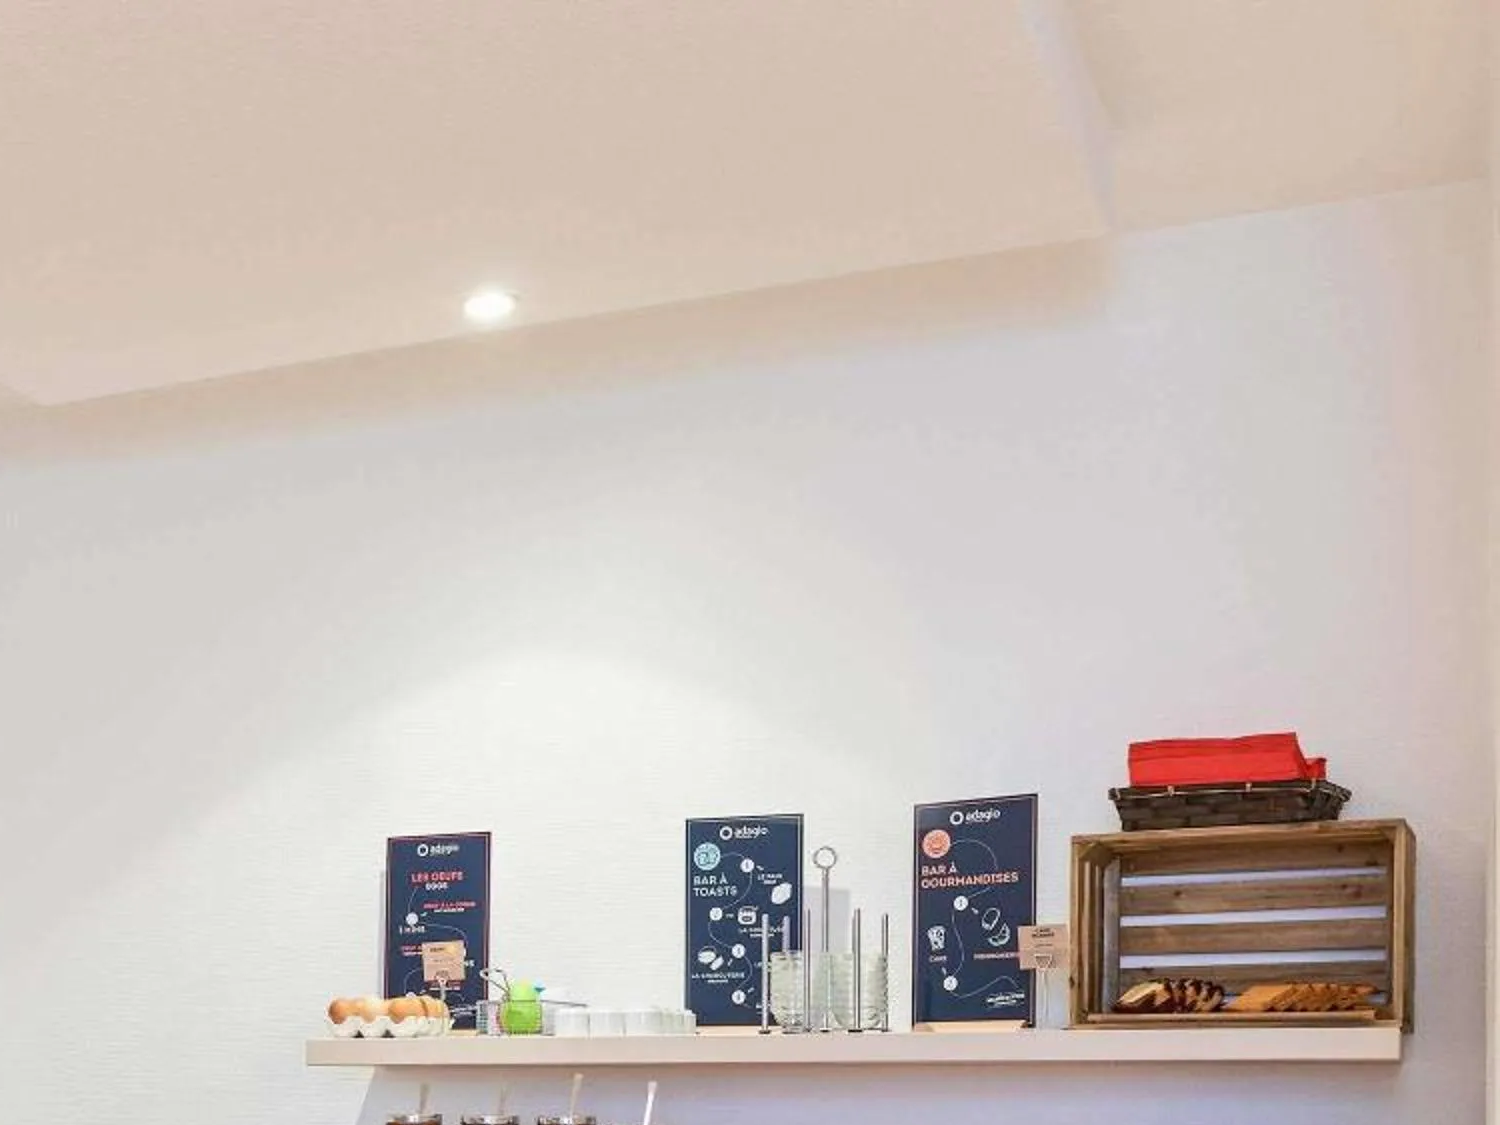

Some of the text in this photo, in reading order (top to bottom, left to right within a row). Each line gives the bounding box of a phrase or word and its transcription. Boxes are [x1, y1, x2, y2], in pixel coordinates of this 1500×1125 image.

[921, 865, 947, 876] BAR
[693, 875, 717, 885] BAR
[921, 871, 1019, 889] GOURMANDISES
